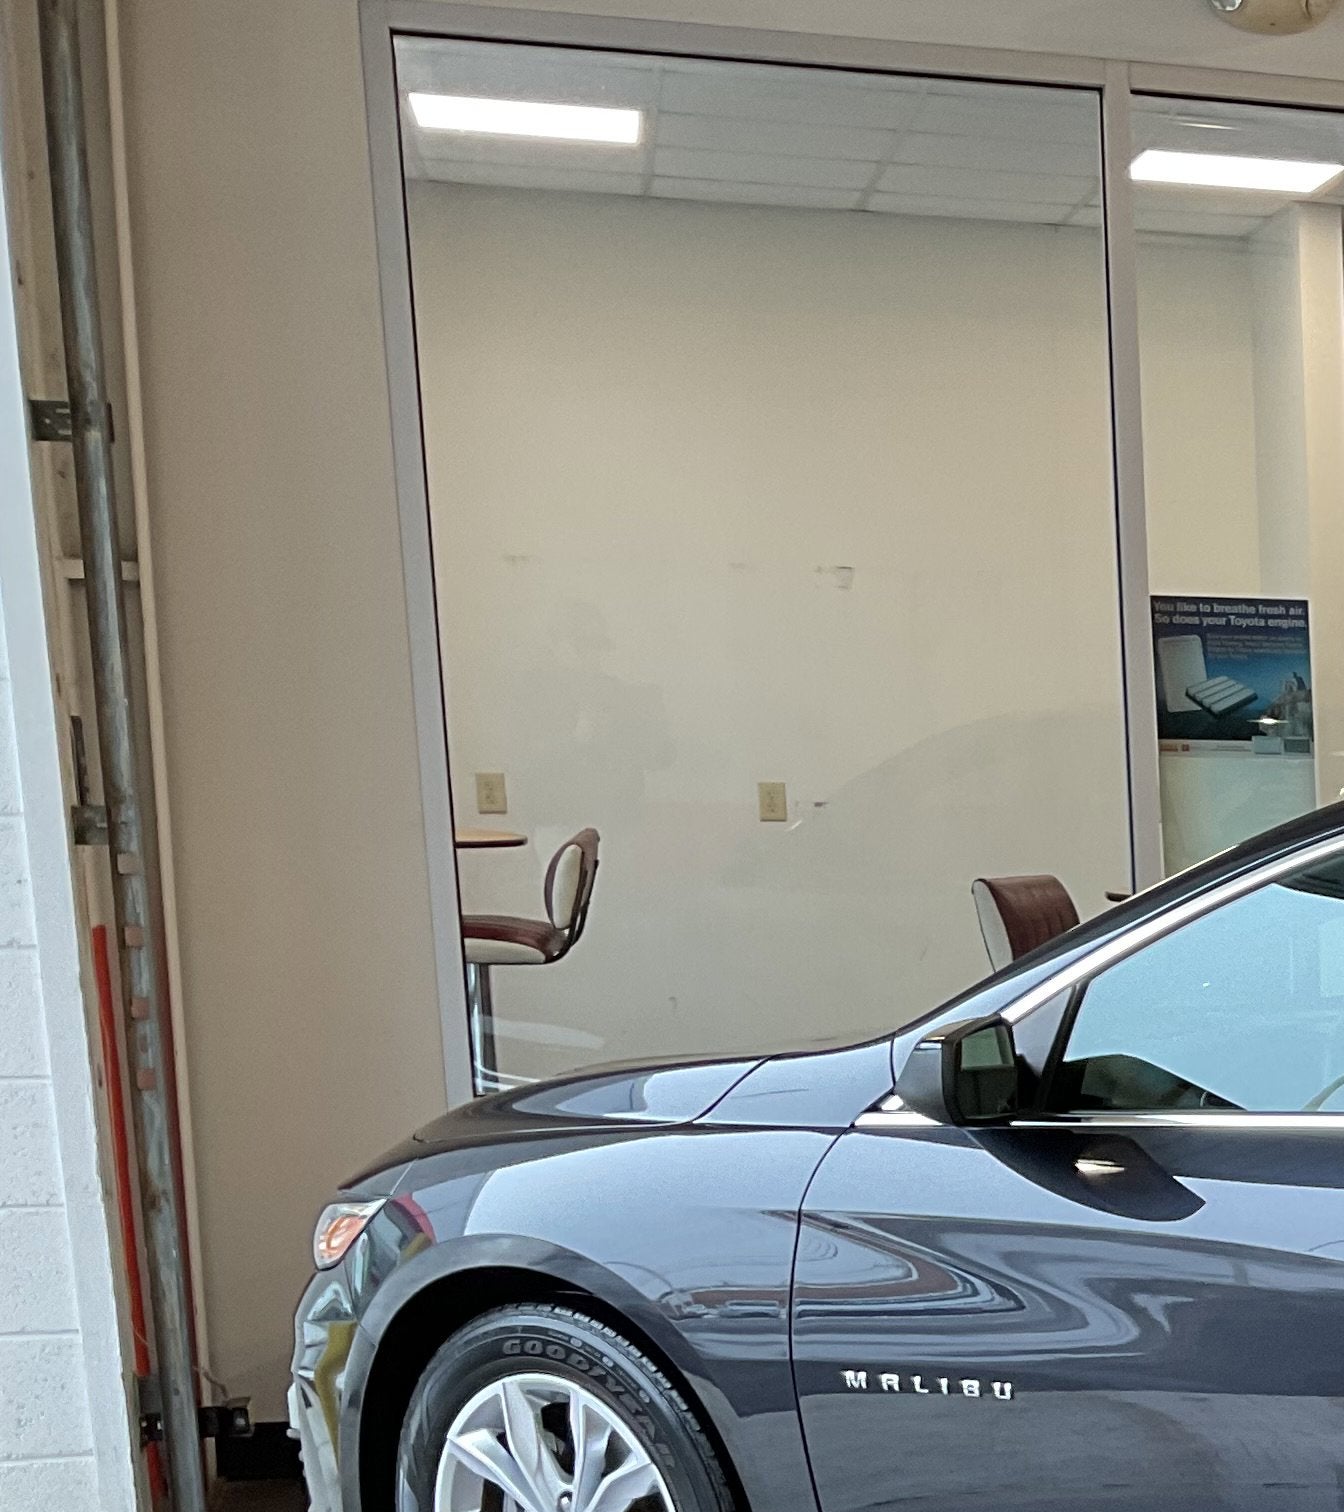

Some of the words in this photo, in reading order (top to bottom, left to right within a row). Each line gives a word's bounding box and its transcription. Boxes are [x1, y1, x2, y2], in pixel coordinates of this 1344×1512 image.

[1154, 601, 1174, 612] You
[1176, 602, 1197, 612] like
[1200, 603, 1211, 613] to
[1213, 603, 1256, 614] breathe
[1258, 604, 1286, 615] fresh
[1289, 606, 1305, 616] air.
[1154, 613, 1170, 624] So
[1172, 614, 1199, 625] does
[1202, 616, 1226, 627] your
[1228, 615, 1265, 628] Toyota
[1267, 618, 1307, 629] engine.
[840, 1369, 1013, 1401] MALIBU
